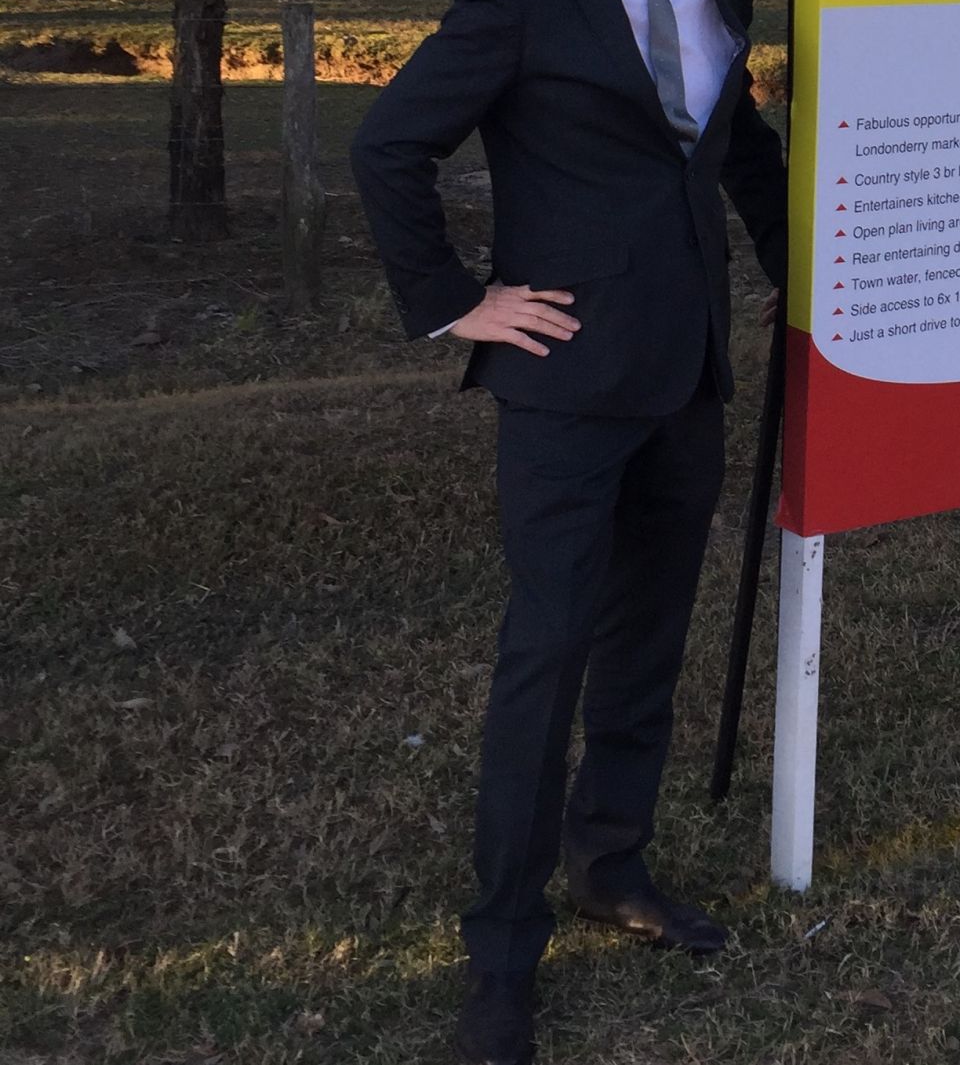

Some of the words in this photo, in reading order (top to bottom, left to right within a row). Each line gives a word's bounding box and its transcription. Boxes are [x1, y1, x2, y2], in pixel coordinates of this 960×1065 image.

[856, 116, 909, 130] Fabulous
[855, 141, 928, 156] Londonderry
[854, 173, 900, 186] Country
[903, 169, 930, 184] style
[932, 167, 940, 179] 3
[943, 166, 955, 178] br
[853, 197, 923, 213] Entertainers
[852, 226, 884, 240] Open
[888, 223, 912, 238] plan
[916, 219, 944, 232] living
[852, 253, 881, 265] Rear
[883, 244, 950, 261] entertaining
[850, 278, 883, 290] Town
[886, 274, 921, 286] water,
[850, 303, 876, 316] Side
[879, 299, 920, 312] access
[923, 296, 934, 306] to
[937, 293, 951, 304] 6x
[849, 329, 873, 342] Just
[876, 329, 884, 338] a
[887, 323, 916, 336] short
[919, 320, 947, 332] drive
[950, 317, 960, 327] to
